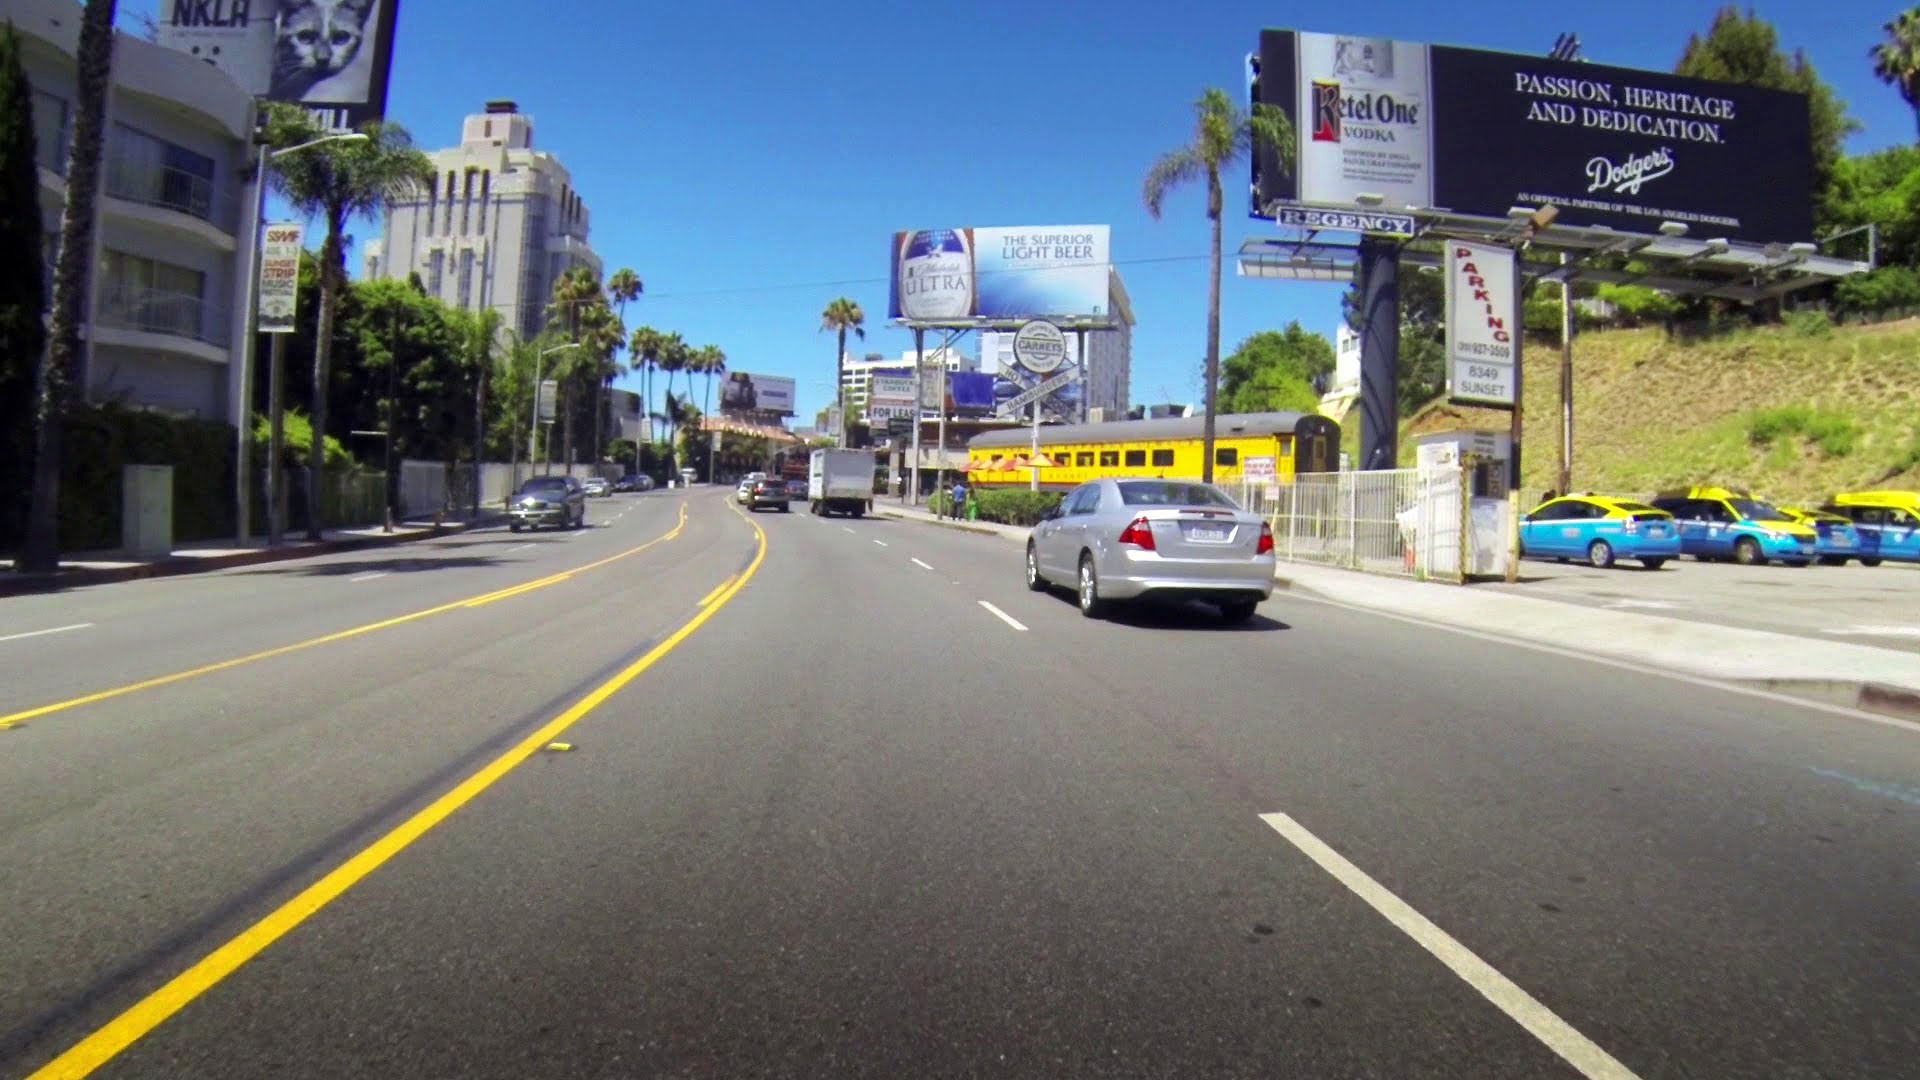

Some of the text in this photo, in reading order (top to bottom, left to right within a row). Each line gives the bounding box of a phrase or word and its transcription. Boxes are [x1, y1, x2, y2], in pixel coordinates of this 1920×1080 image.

[171, 0, 248, 28] NKLA
[1515, 72, 1736, 119] PASSION, HERITAGE
[1311, 83, 1418, 142] Ketel One
[1527, 101, 1726, 144] AND DEDICATION.
[1343, 126, 1396, 142] VODKA
[1586, 148, 1674, 195] Dodgers
[1530, 193, 1571, 206] OFFICIAL
[1572, 198, 1610, 212] PARTNER
[1611, 203, 1624, 212] OF
[1625, 204, 1642, 214] THE
[1644, 207, 1660, 217] LOS
[1661, 209, 1698, 222] ANGELES
[1283, 210, 1409, 233] REGENCY
[1003, 234, 1094, 246] THE SUPERIOR
[1002, 246, 1094, 260] LIGHT BEER
[263, 267, 297, 279] STRIP
[905, 274, 967, 296] ULTRA
[1456, 247, 1510, 344] PARKING
[1018, 339, 1063, 354] CARNEYS
[1469, 365, 1499, 380] 8349
[1006, 375, 1070, 411] HAMBURGERS
[1461, 380, 1505, 396] SUNSET
[873, 407, 915, 419] FOR LEAS
